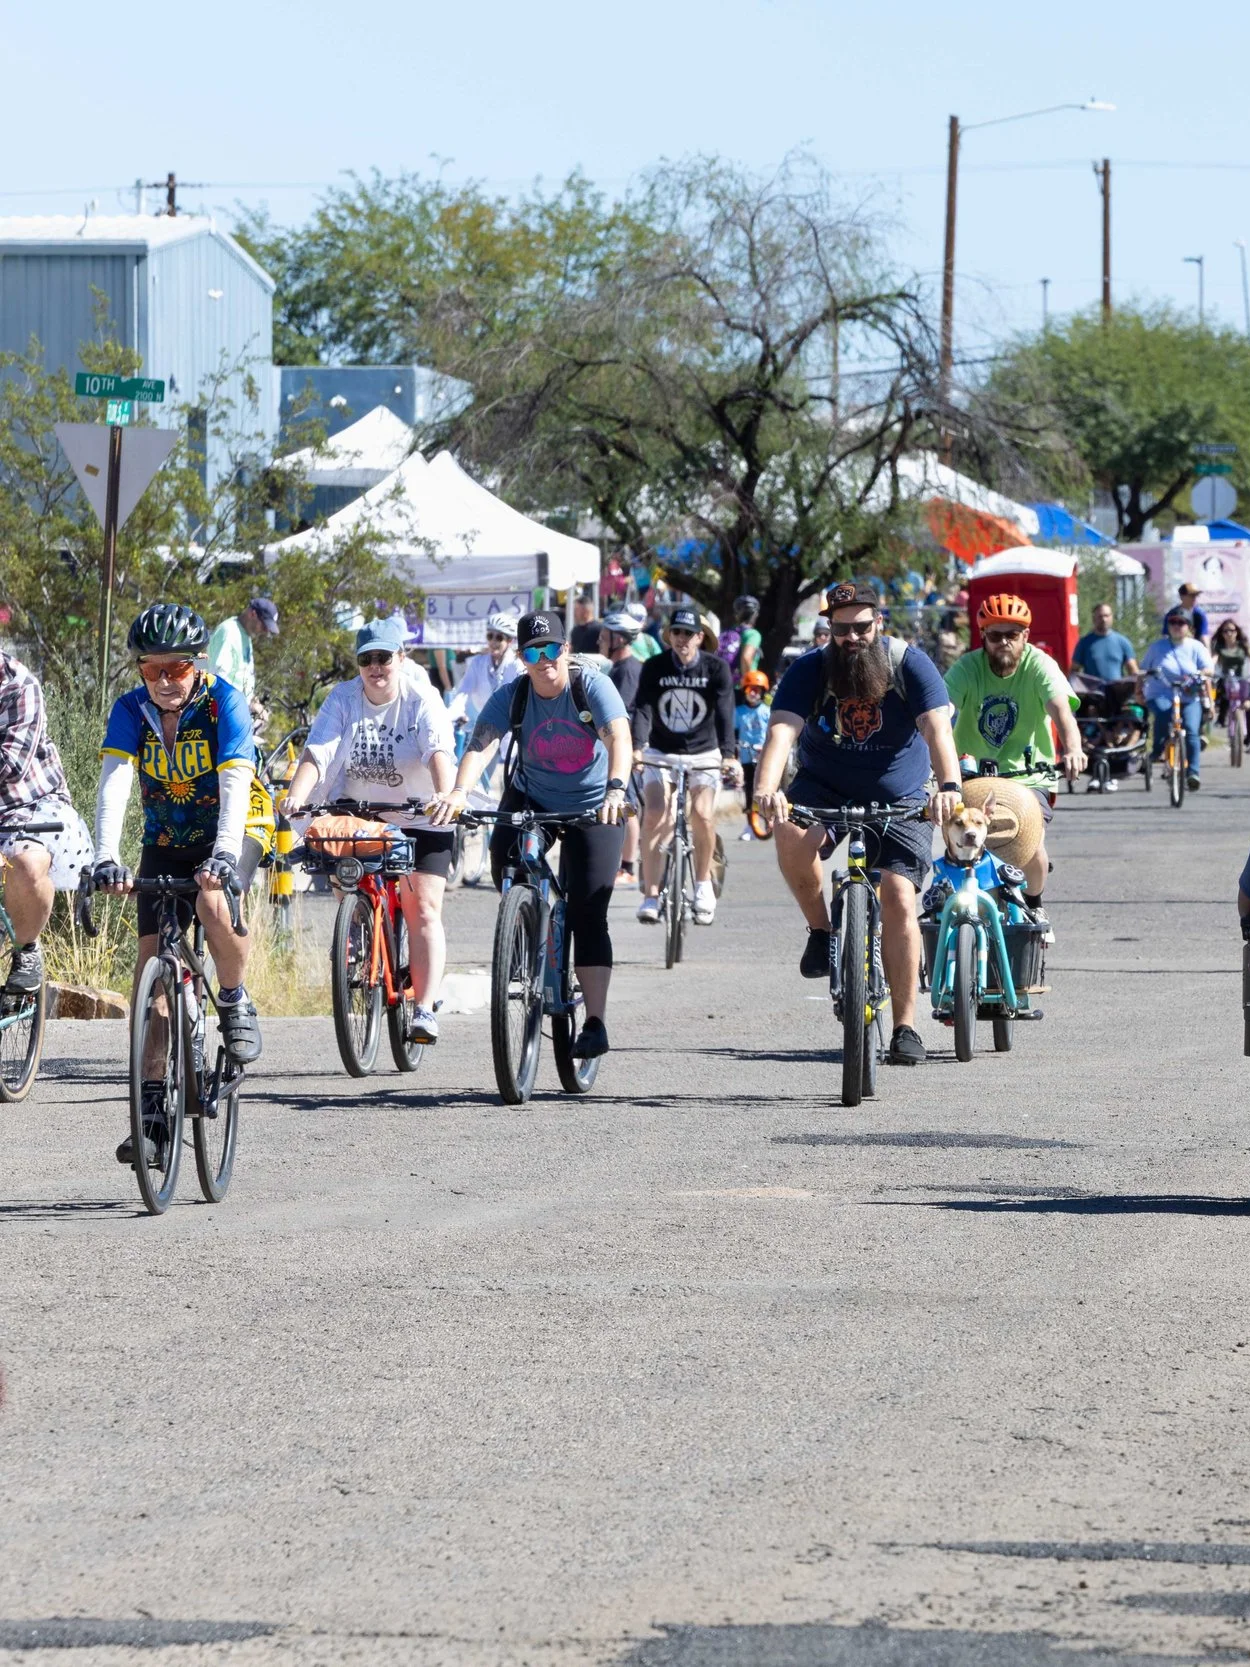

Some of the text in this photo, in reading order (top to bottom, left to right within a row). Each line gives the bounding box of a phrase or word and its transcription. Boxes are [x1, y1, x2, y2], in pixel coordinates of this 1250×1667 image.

[85, 376, 115, 395] 10TH
[142, 380, 157, 390] AVE
[134, 391, 162, 403] 2100 N
[354, 742, 394, 751] POWER
[141, 742, 209, 782] PEACE
